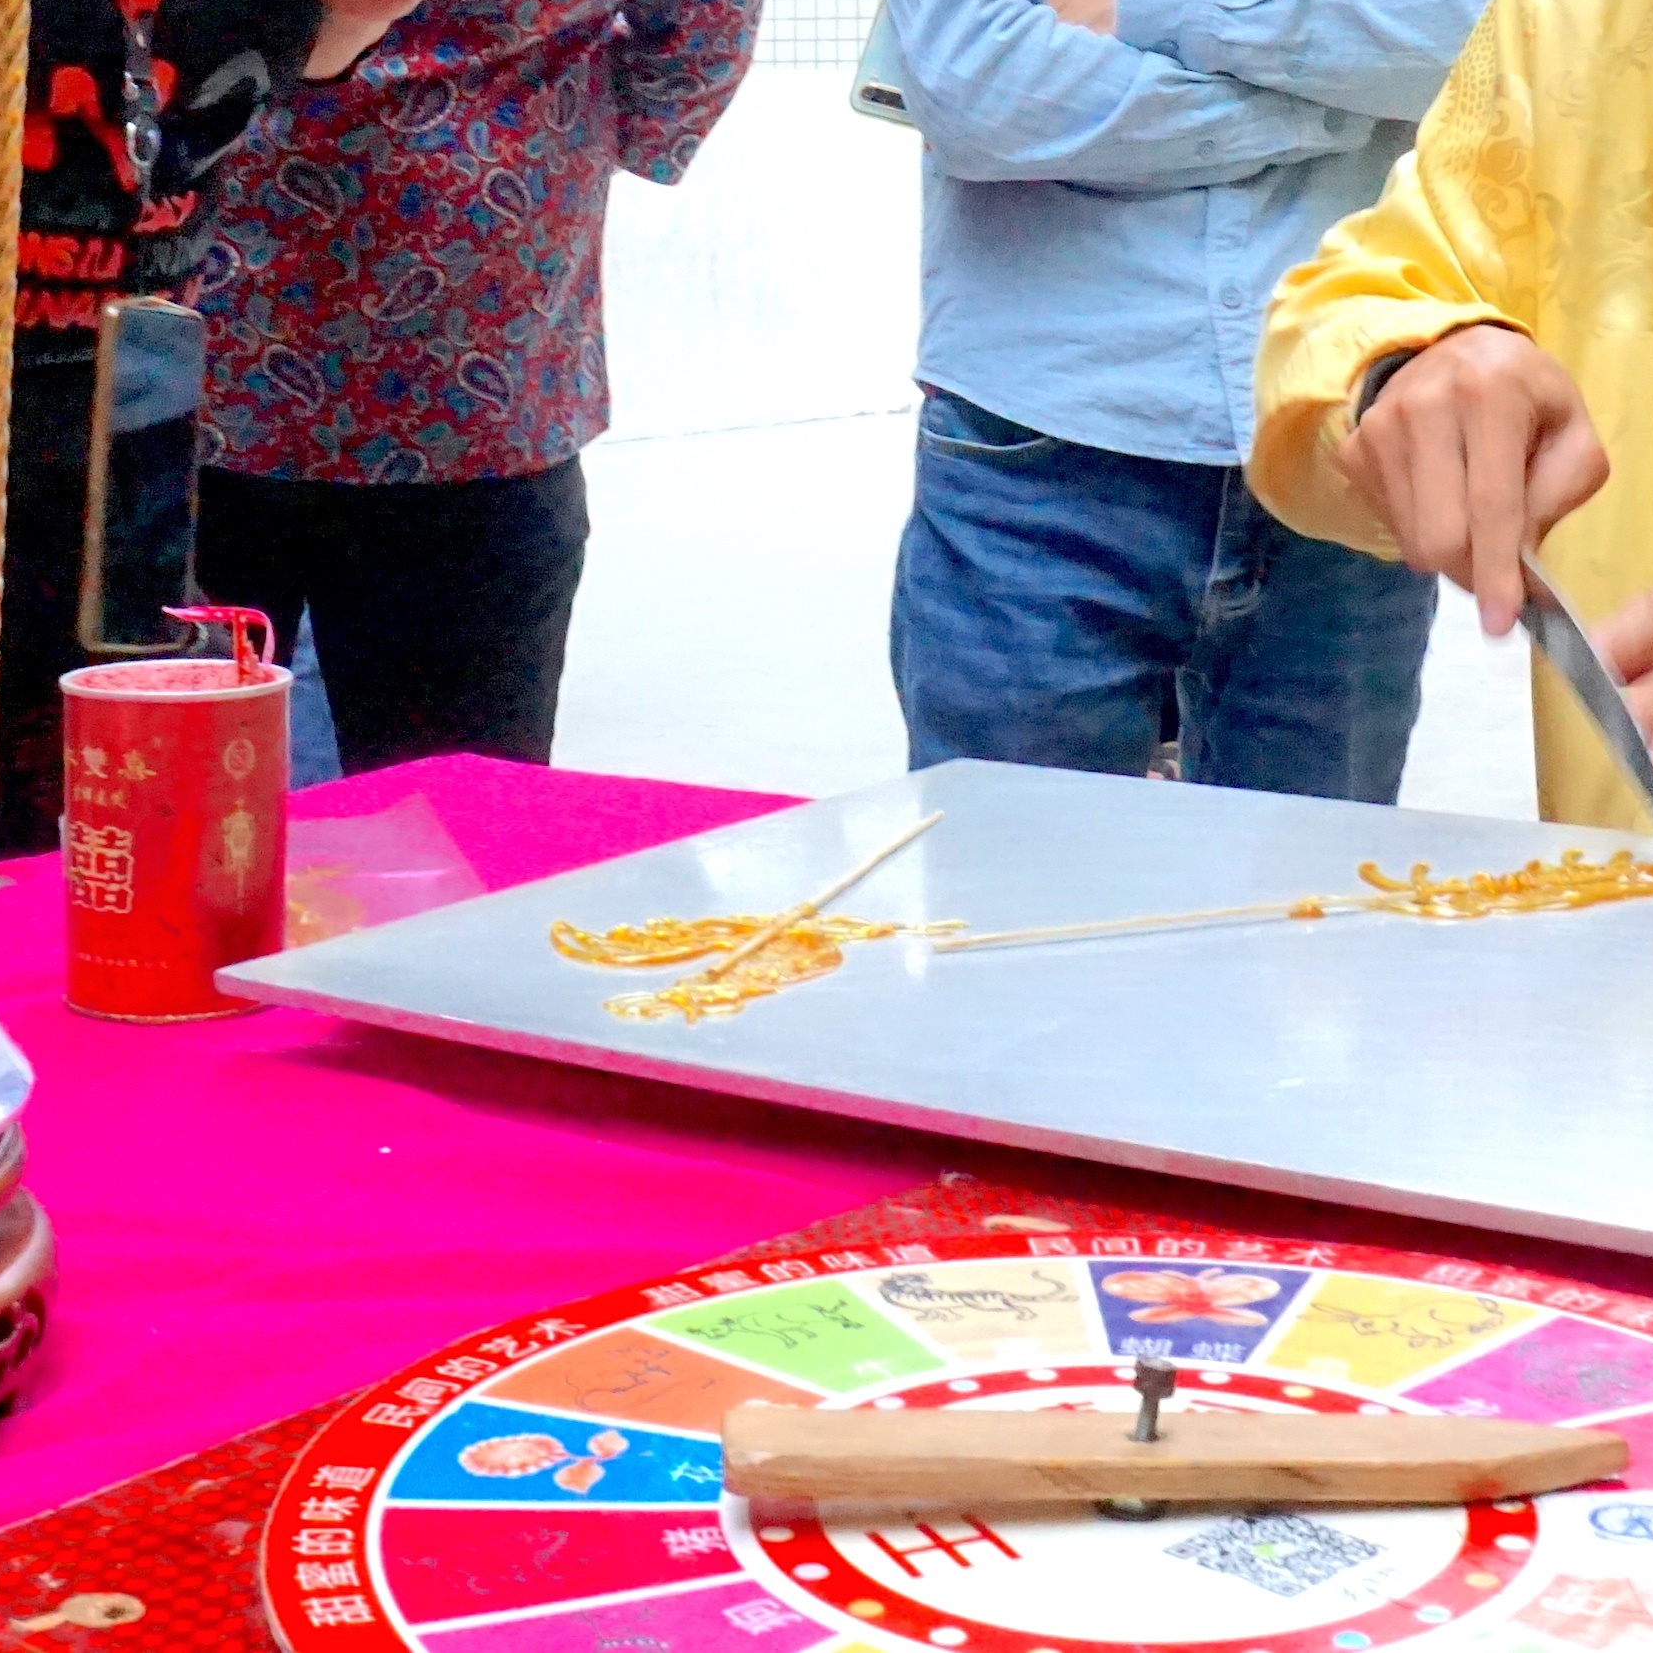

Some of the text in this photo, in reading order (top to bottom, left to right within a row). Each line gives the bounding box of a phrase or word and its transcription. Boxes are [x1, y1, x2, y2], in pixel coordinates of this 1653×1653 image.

[640, 1243, 938, 1306] 甜蜜的味道
[1027, 1236, 1338, 1266] 民间的艺术
[361, 1318, 588, 1428] 民间的艺术
[291, 1464, 377, 1629] 甜蜜的味道
